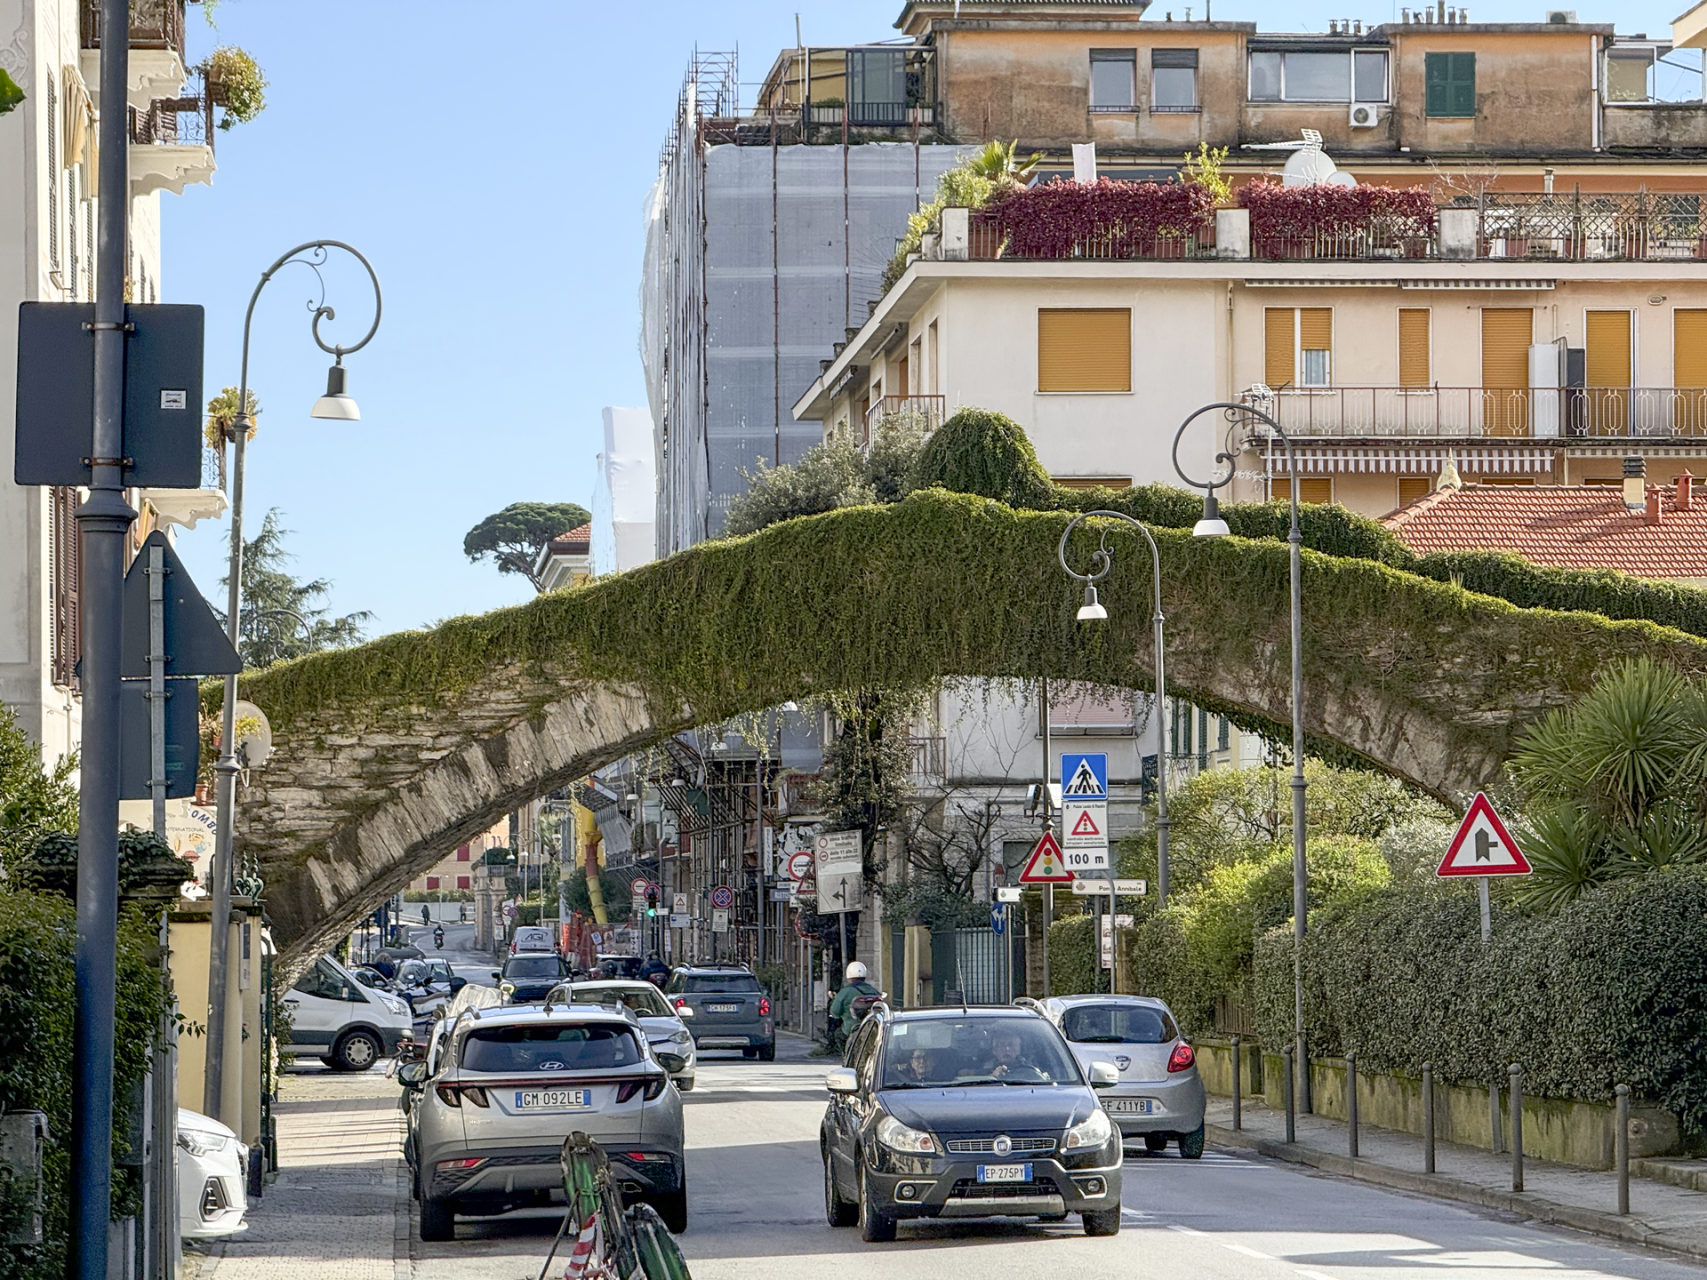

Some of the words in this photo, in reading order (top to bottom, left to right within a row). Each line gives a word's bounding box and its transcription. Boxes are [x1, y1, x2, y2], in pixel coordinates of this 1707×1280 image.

[1069, 854, 1089, 864] 100
[1095, 856, 1104, 864] m
[524, 1093, 539, 1106] GM
[543, 1091, 582, 1105] 092LE
[986, 1169, 996, 1179] EP
[998, 1168, 1024, 1179] 275PY
